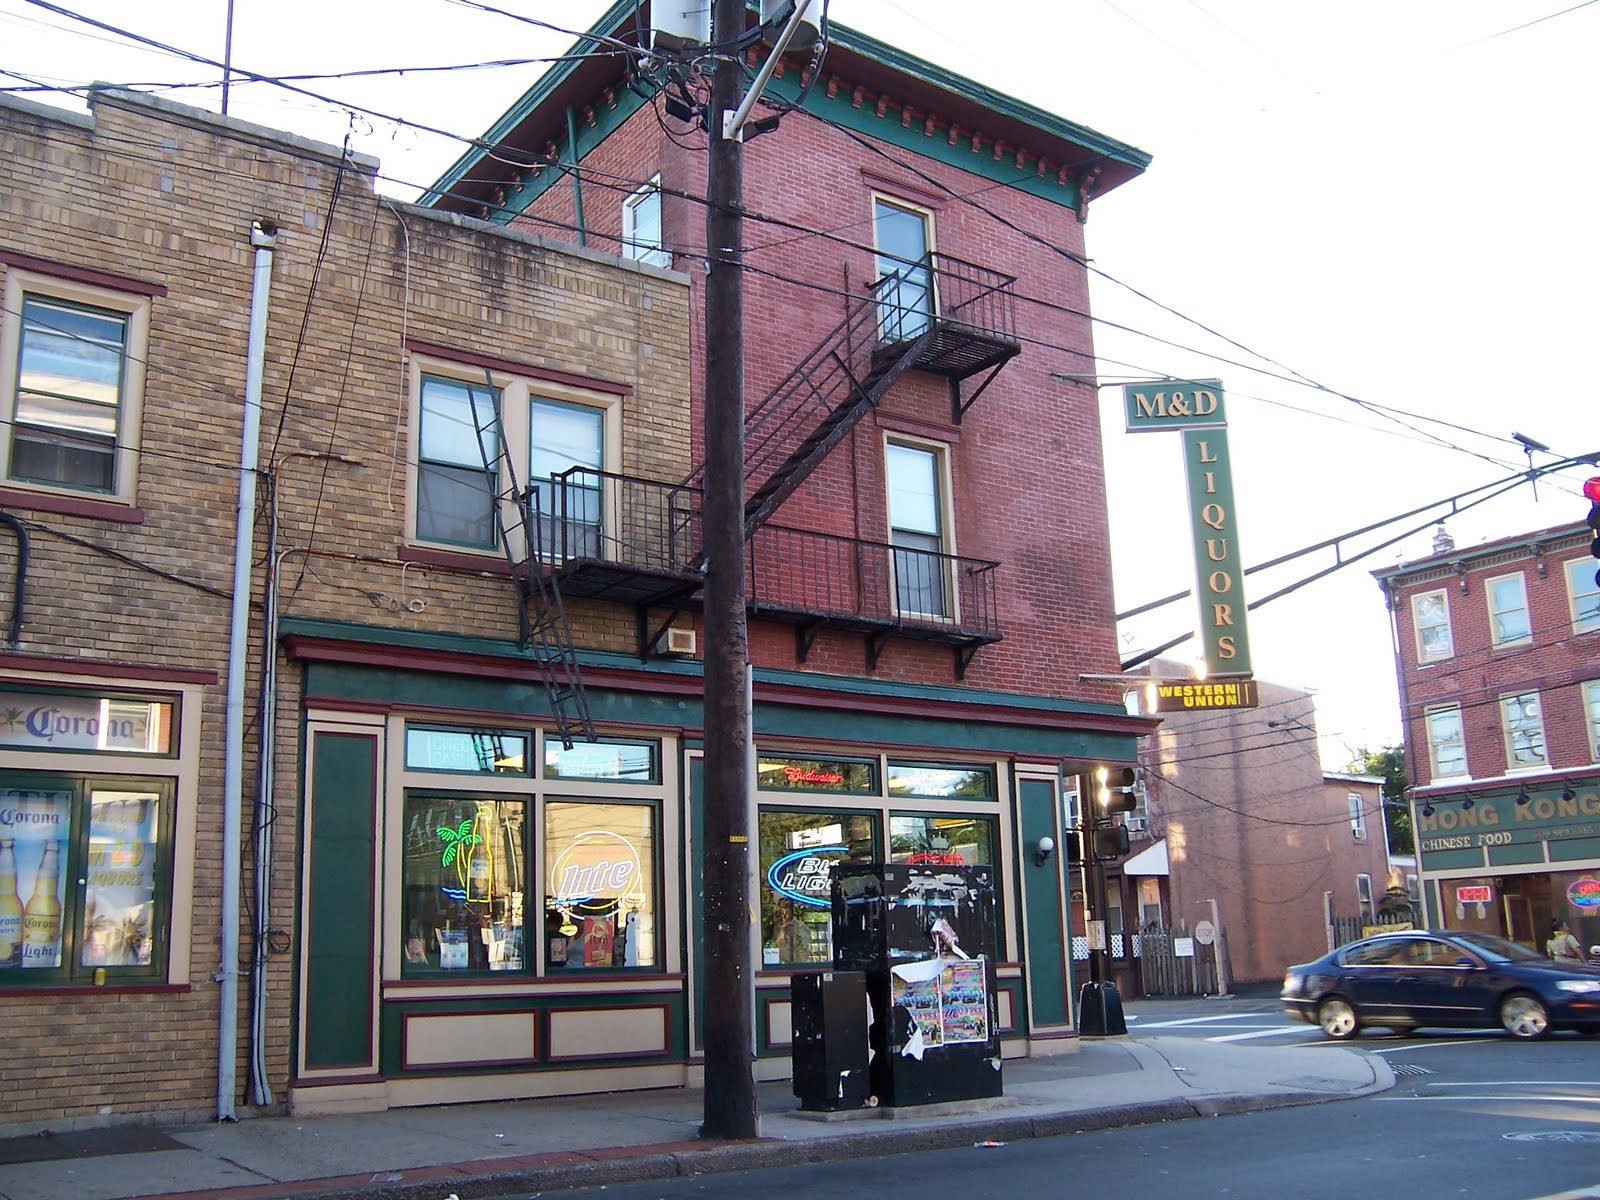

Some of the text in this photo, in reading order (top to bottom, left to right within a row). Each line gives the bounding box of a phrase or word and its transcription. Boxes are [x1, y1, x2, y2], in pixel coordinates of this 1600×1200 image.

[1133, 391, 1218, 418] M&D
[1197, 441, 1236, 660] LIQUORS
[1159, 684, 1237, 697] WESTERN
[1183, 695, 1237, 707] UNION
[25, 706, 135, 742] Corona
[784, 765, 843, 783] Budweiser
[0, 808, 60, 828] Corona
[1420, 793, 1600, 832] HONG KONG
[1422, 832, 1512, 850] CHINESE FOOD
[1458, 888, 1489, 900] OPEN
[1197, 928, 1215, 937] STOP
